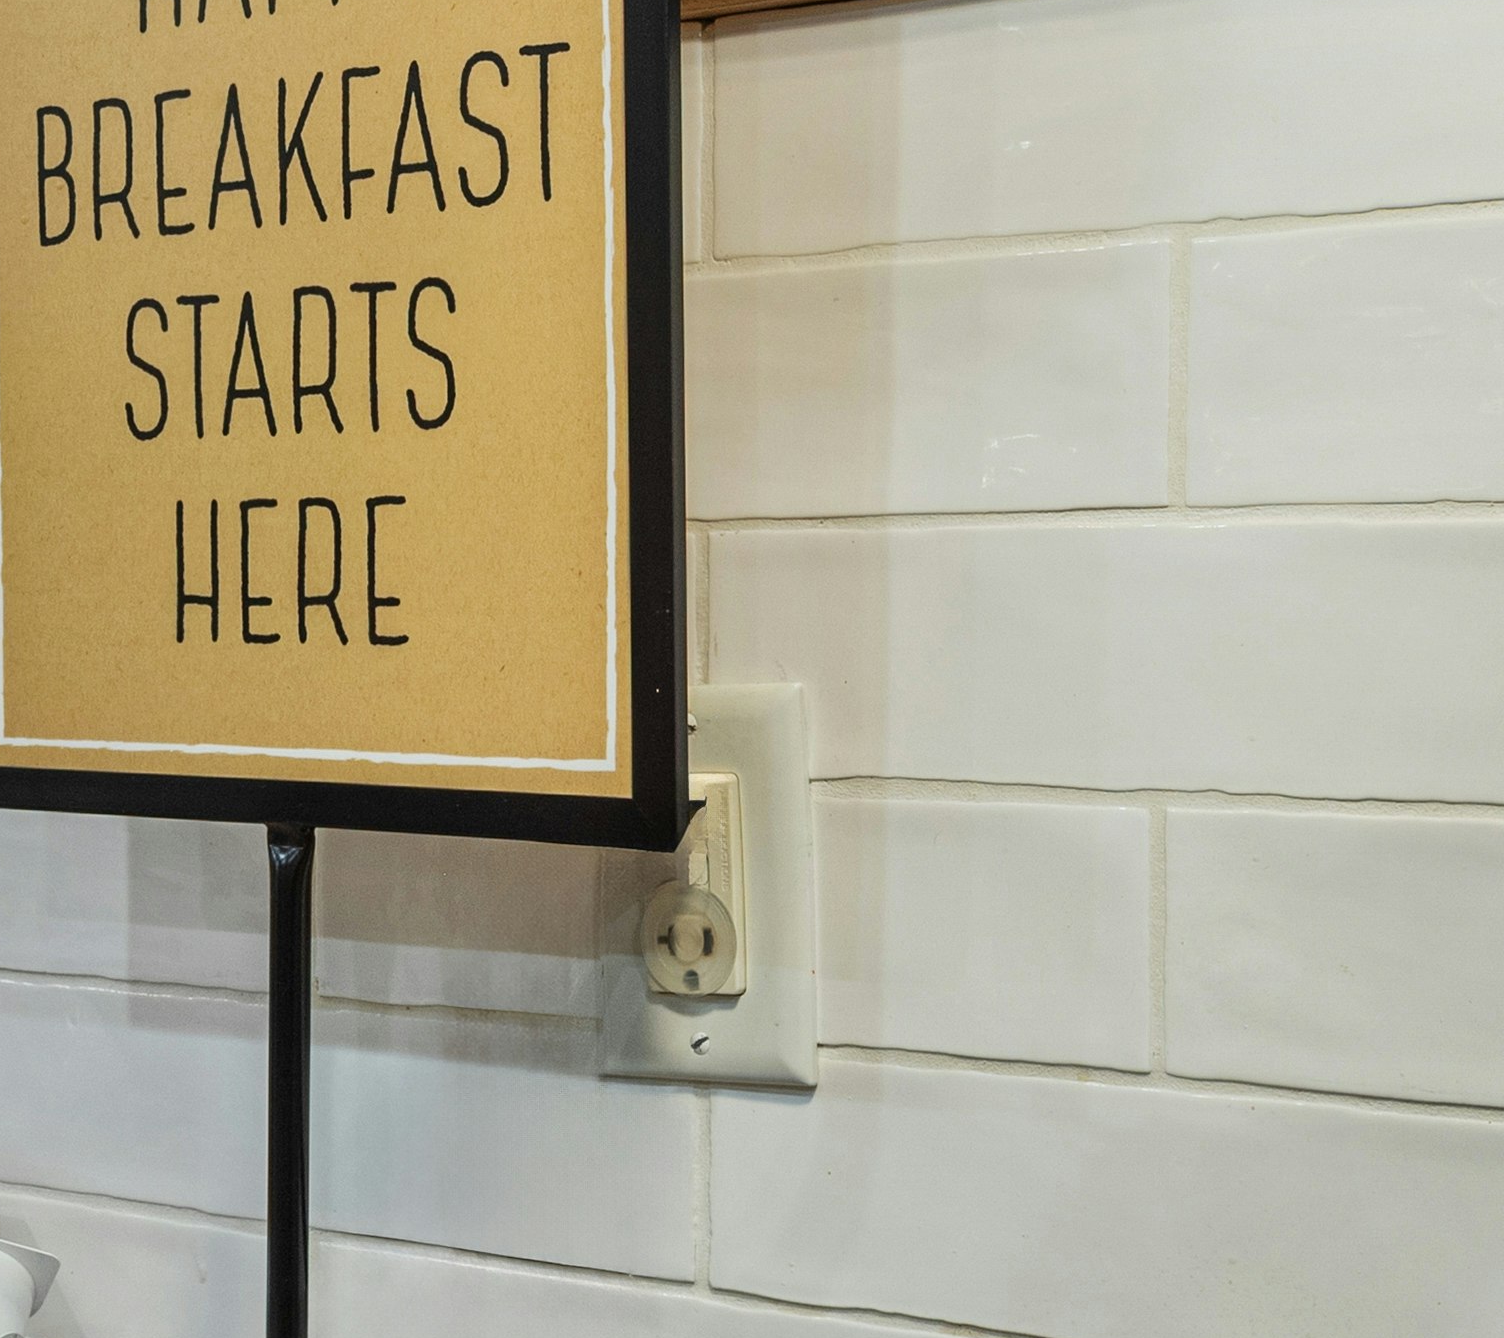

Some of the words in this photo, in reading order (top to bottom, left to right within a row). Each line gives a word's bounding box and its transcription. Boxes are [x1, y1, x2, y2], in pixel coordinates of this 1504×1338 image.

[35, 41, 571, 248] BREAKFAST
[123, 277, 459, 443] STARTS
[174, 494, 410, 648] HERE
